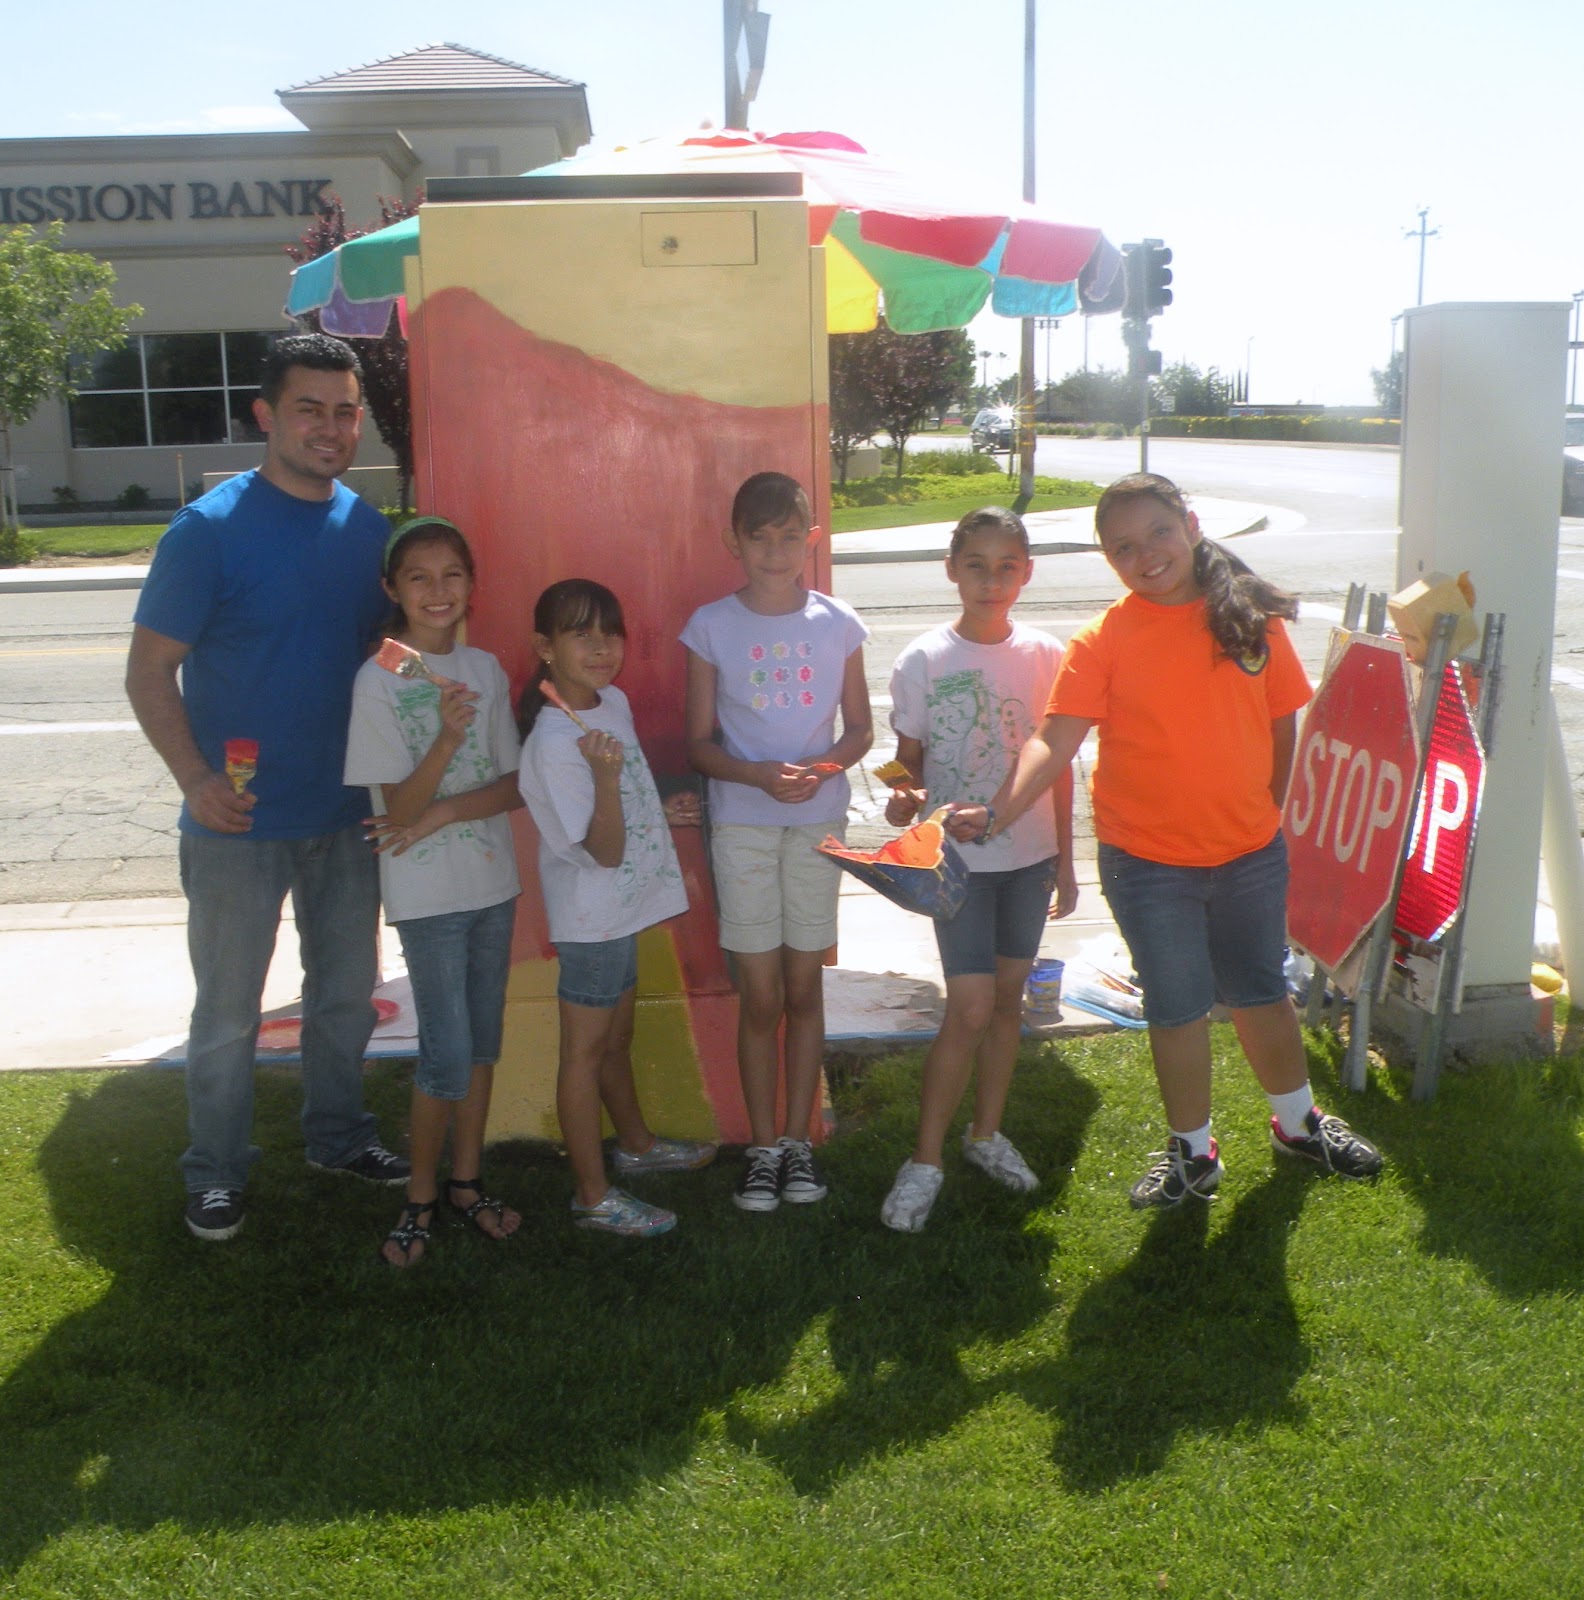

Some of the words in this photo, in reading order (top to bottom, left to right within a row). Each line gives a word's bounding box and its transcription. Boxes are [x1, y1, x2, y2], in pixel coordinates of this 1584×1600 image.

[0, 184, 175, 223] ISSION
[188, 179, 332, 218] BANK
[1291, 731, 1402, 873] STOP
